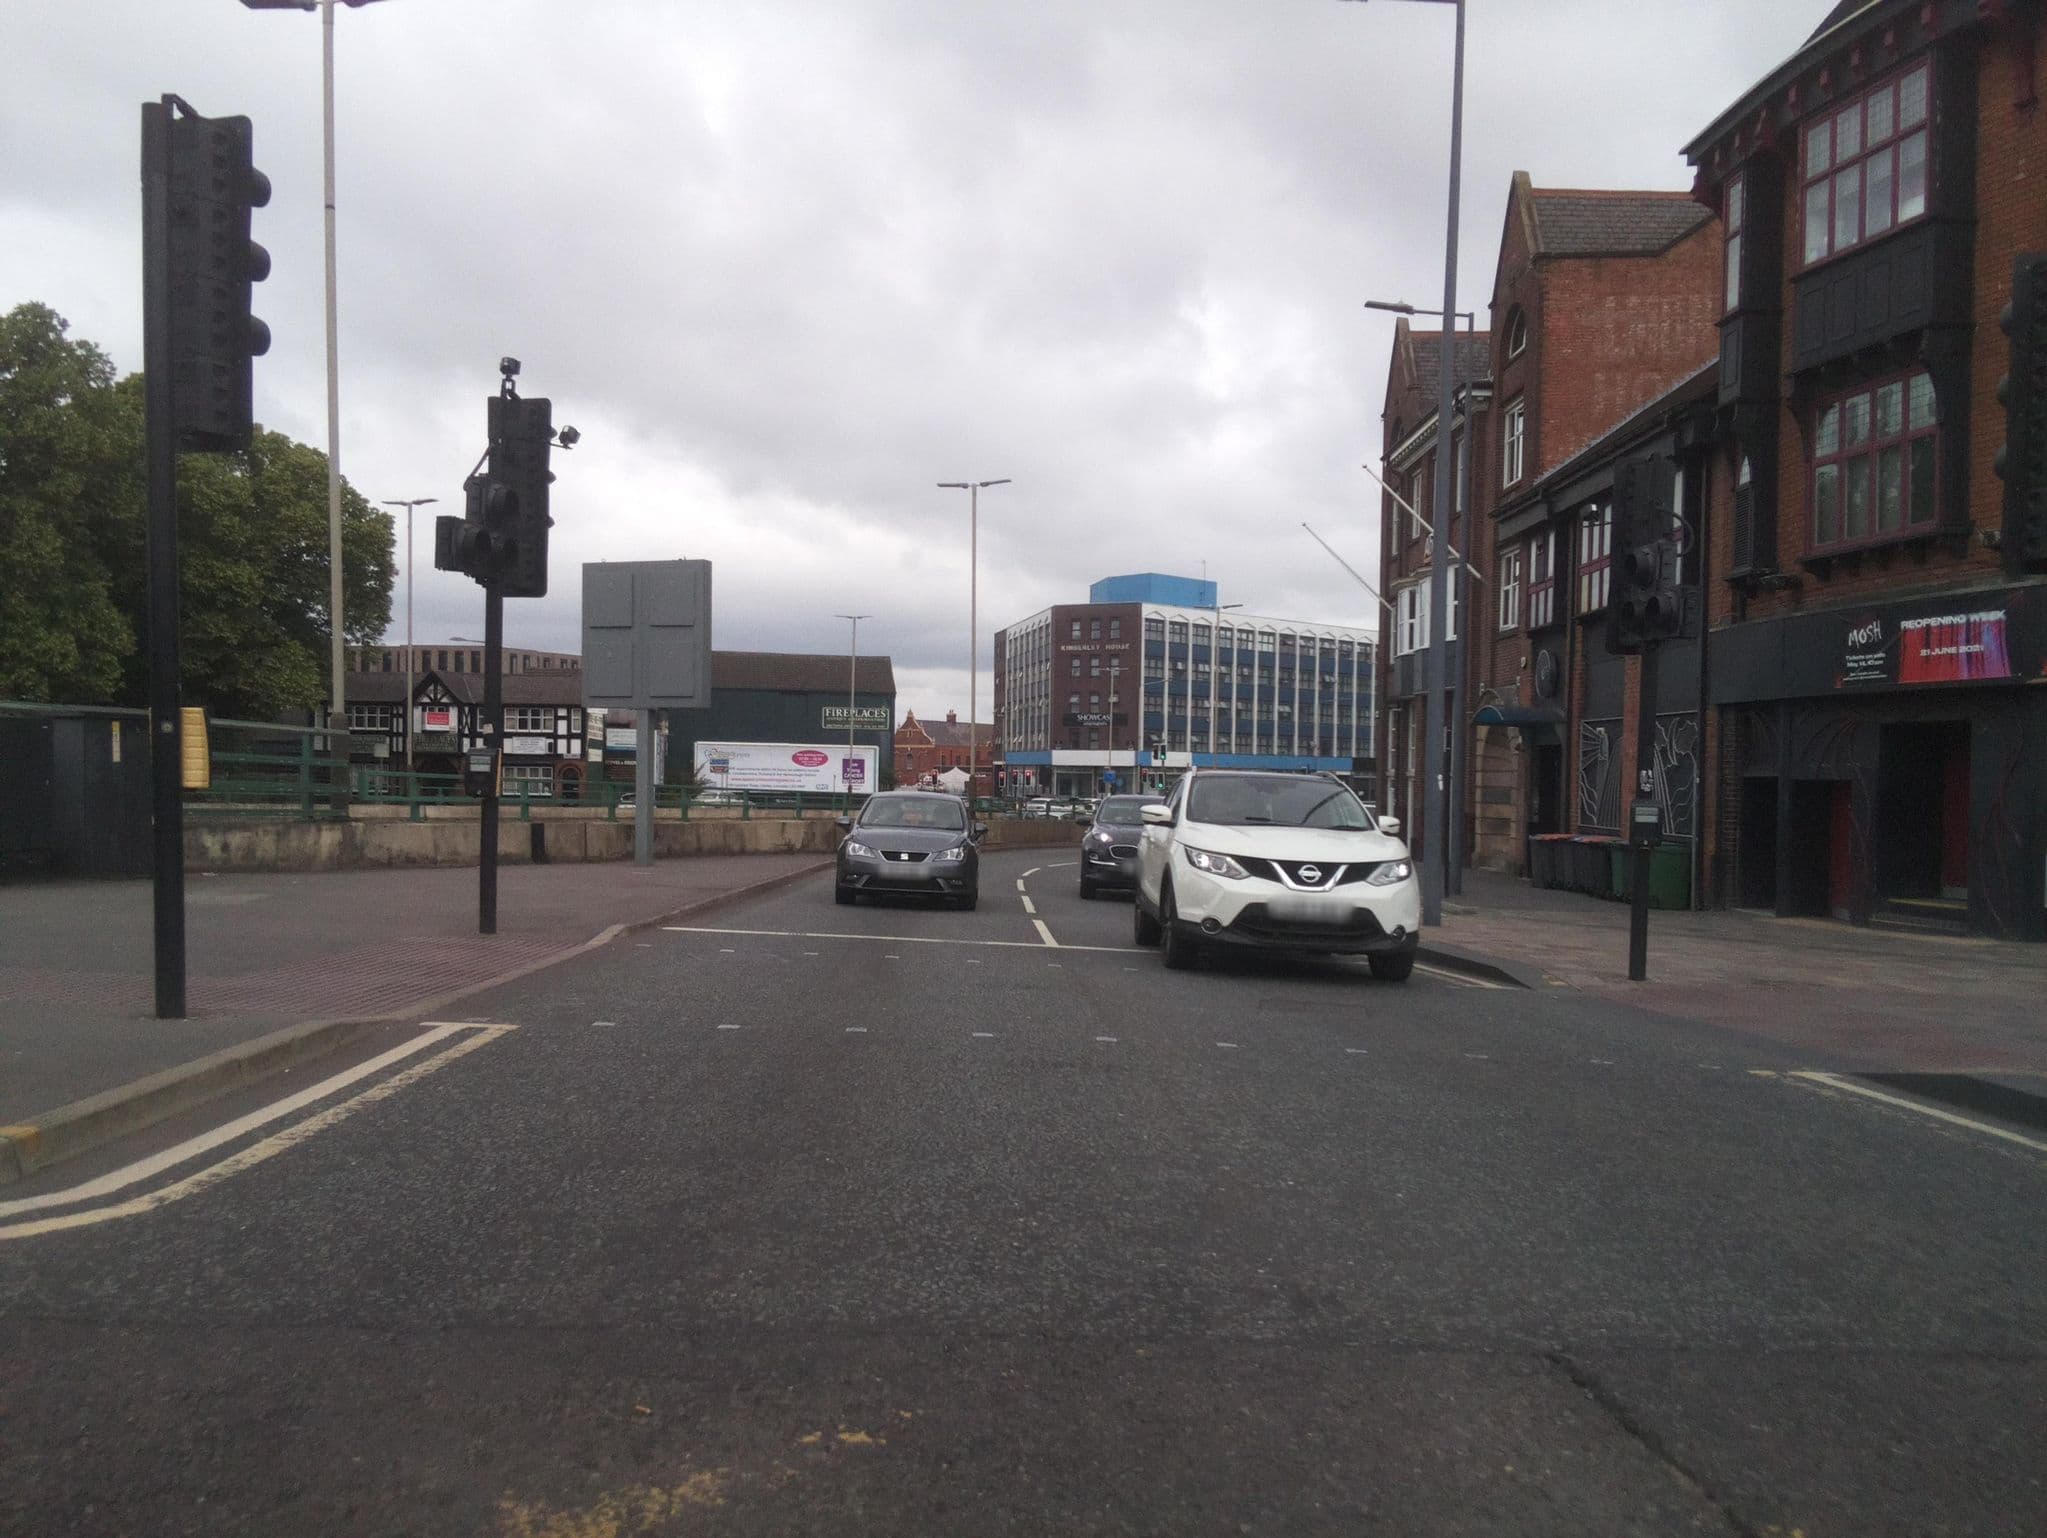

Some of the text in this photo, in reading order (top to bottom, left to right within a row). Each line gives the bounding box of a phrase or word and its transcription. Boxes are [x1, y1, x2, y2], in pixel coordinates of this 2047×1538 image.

[1900, 609, 2007, 630] REOPENING WEEK
[1848, 620, 1882, 649] MOSH
[1931, 646, 1957, 655] JUNE
[825, 708, 886, 717] FIREPLACES
[1077, 713, 1112, 721] SHOWCAS
